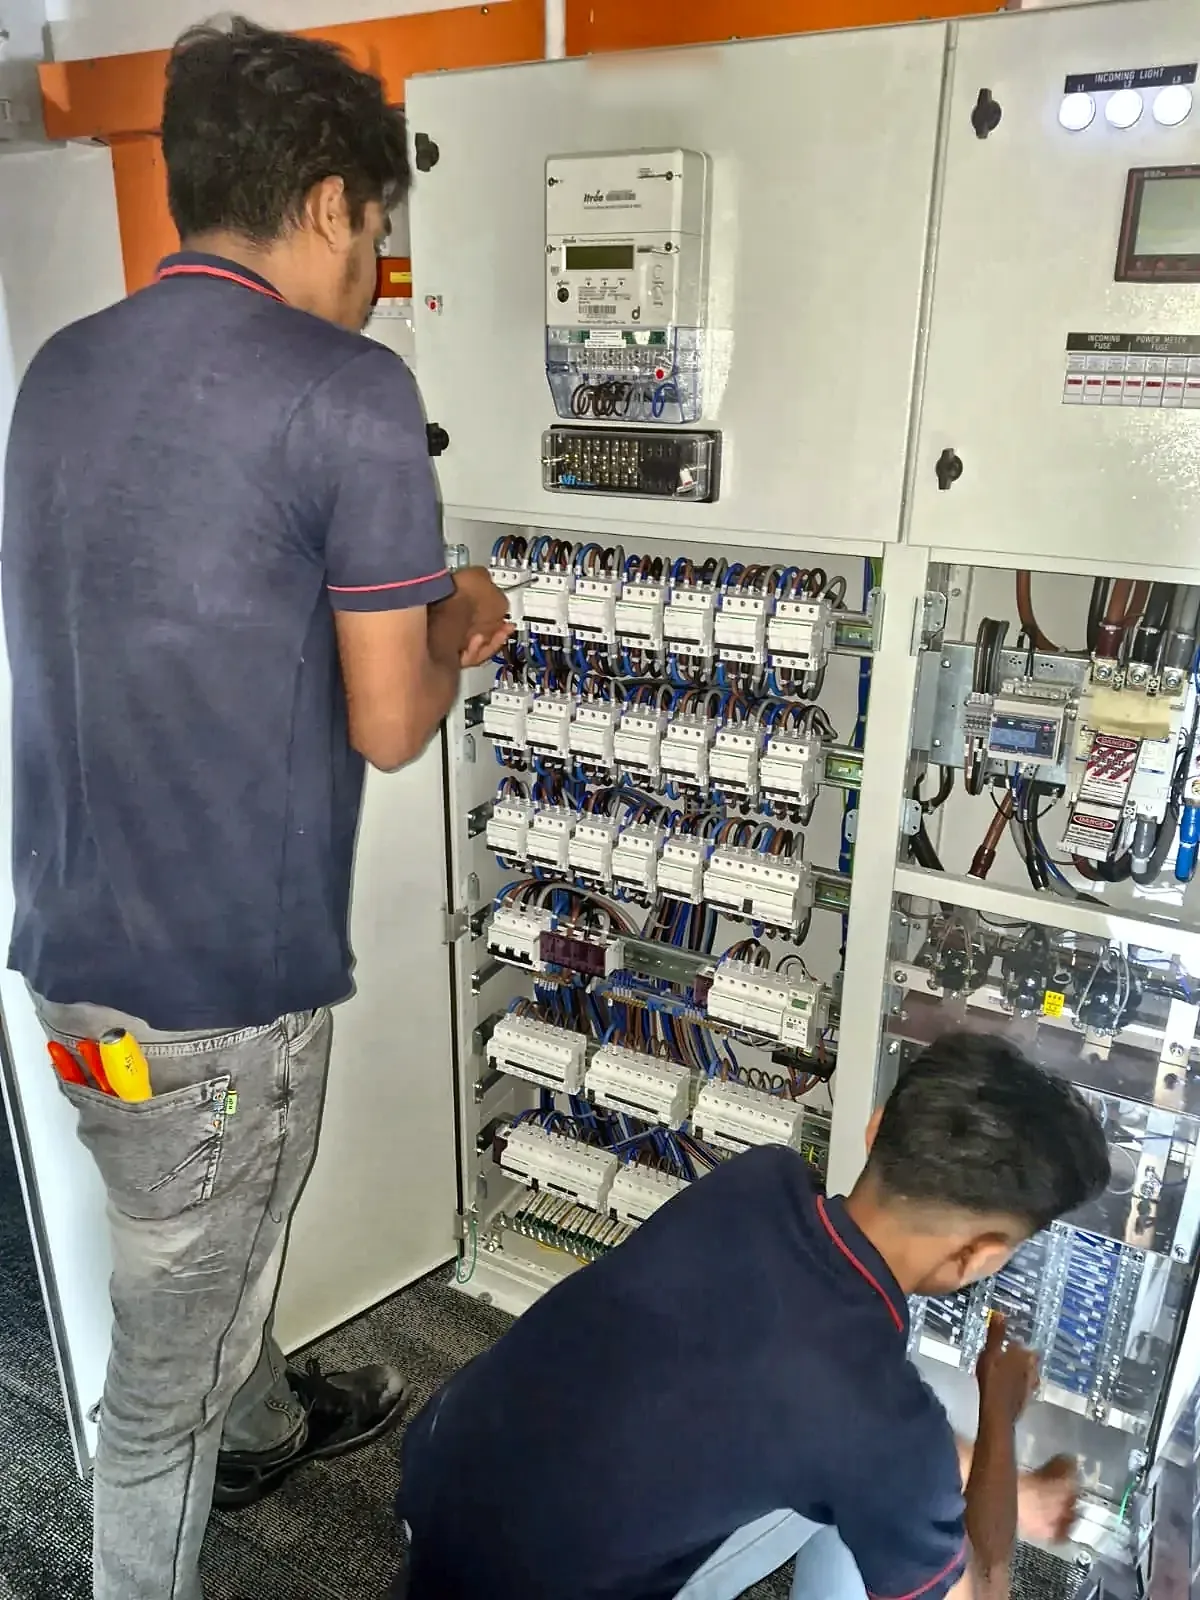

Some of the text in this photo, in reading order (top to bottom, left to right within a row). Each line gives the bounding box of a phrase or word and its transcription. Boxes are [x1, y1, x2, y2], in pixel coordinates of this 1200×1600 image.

[1095, 67, 1164, 84] INCOMING LIGHT
[1077, 83, 1085, 92] L1
[1123, 80, 1132, 89] L2
[1087, 335, 1120, 343] INCOMING
[1136, 335, 1187, 344] POWER METER
[1094, 342, 1112, 350] FUSE
[1151, 343, 1169, 351] FUSE
[1101, 737, 1132, 748] DANGER
[1079, 816, 1110, 828] DANGER
